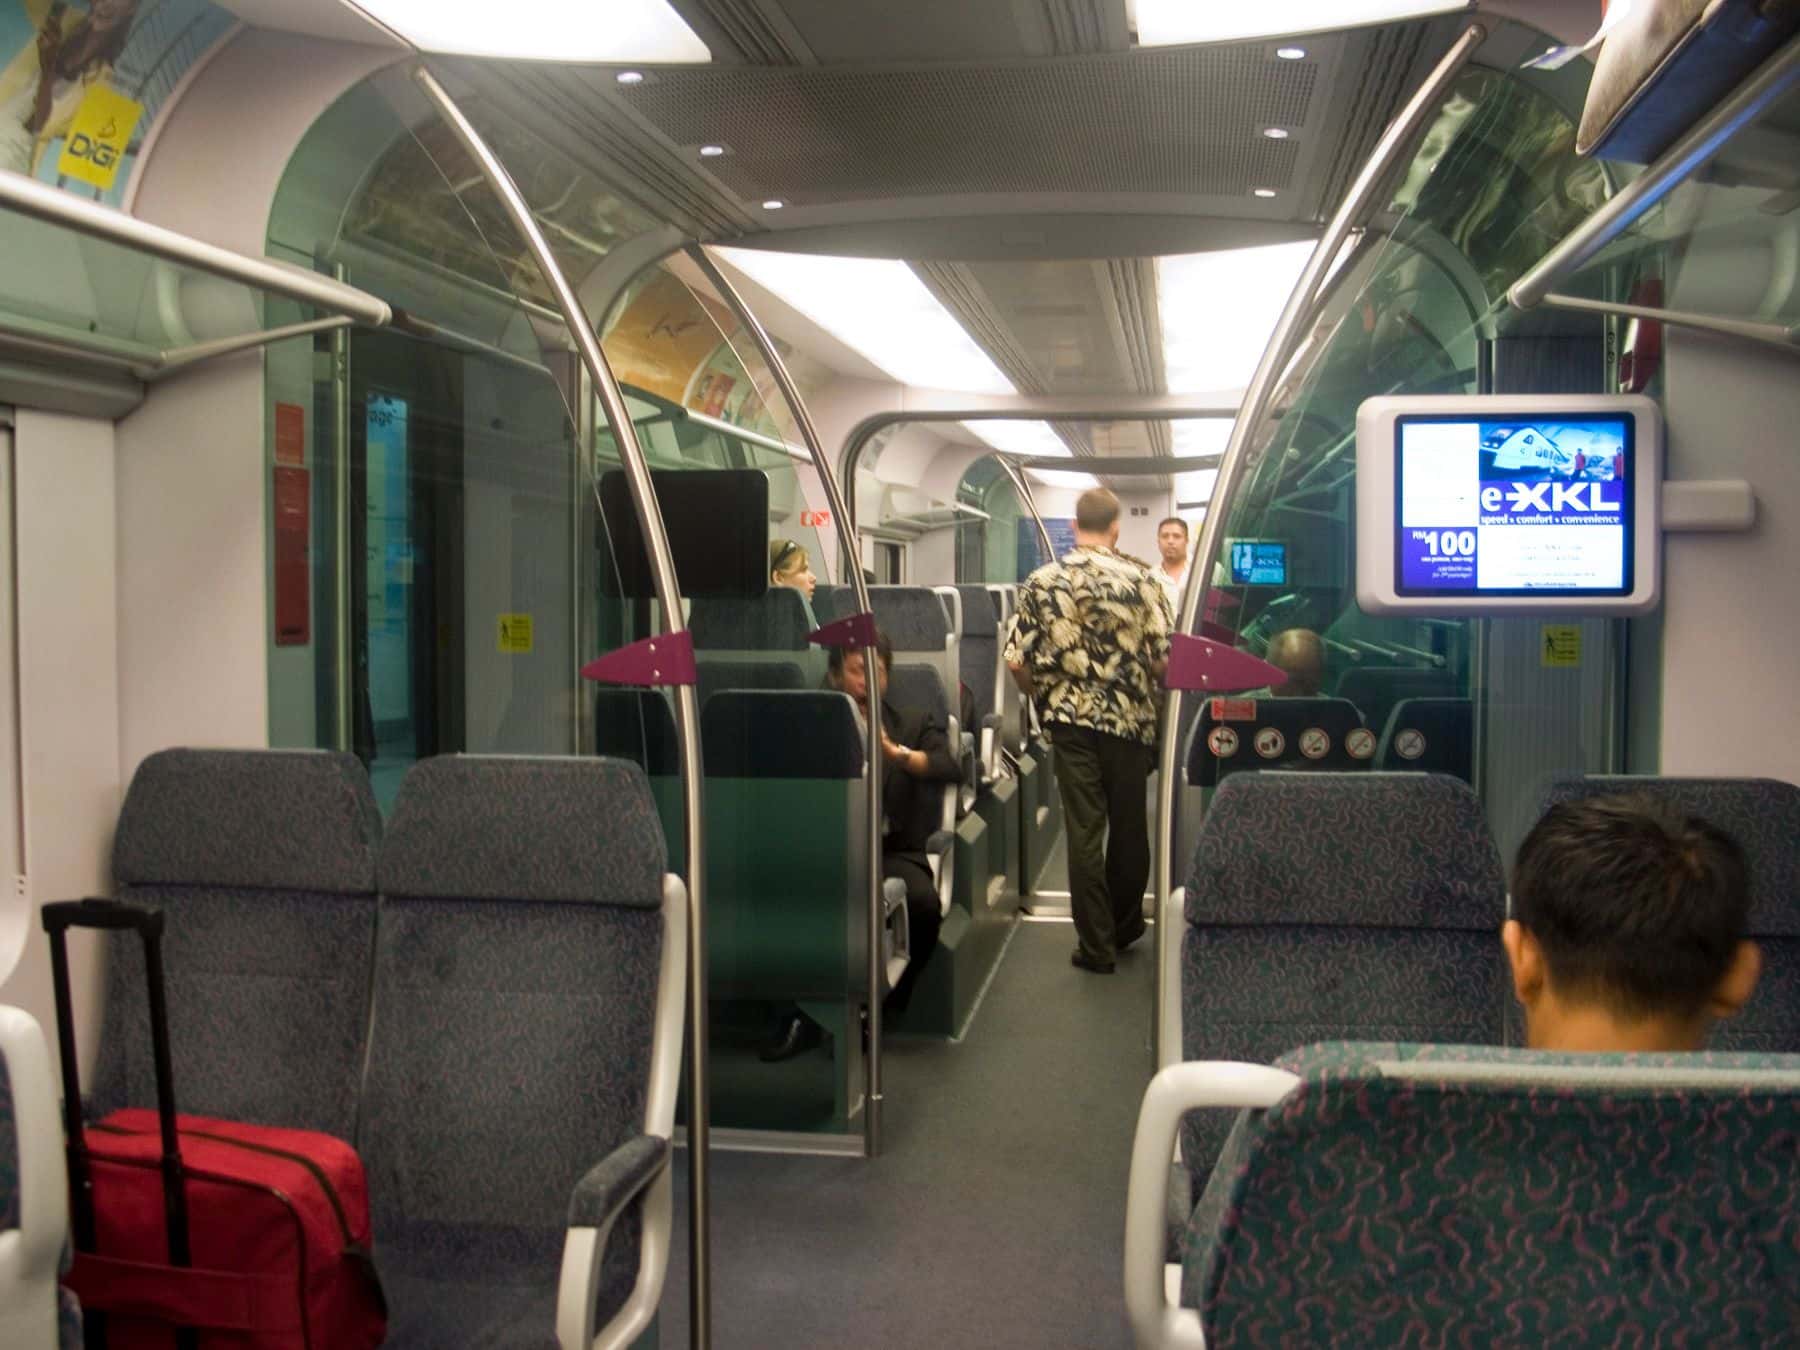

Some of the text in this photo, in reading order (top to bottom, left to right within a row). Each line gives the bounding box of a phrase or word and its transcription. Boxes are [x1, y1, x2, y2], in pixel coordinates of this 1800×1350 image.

[1480, 513, 1618, 525] speed comfort convenience
